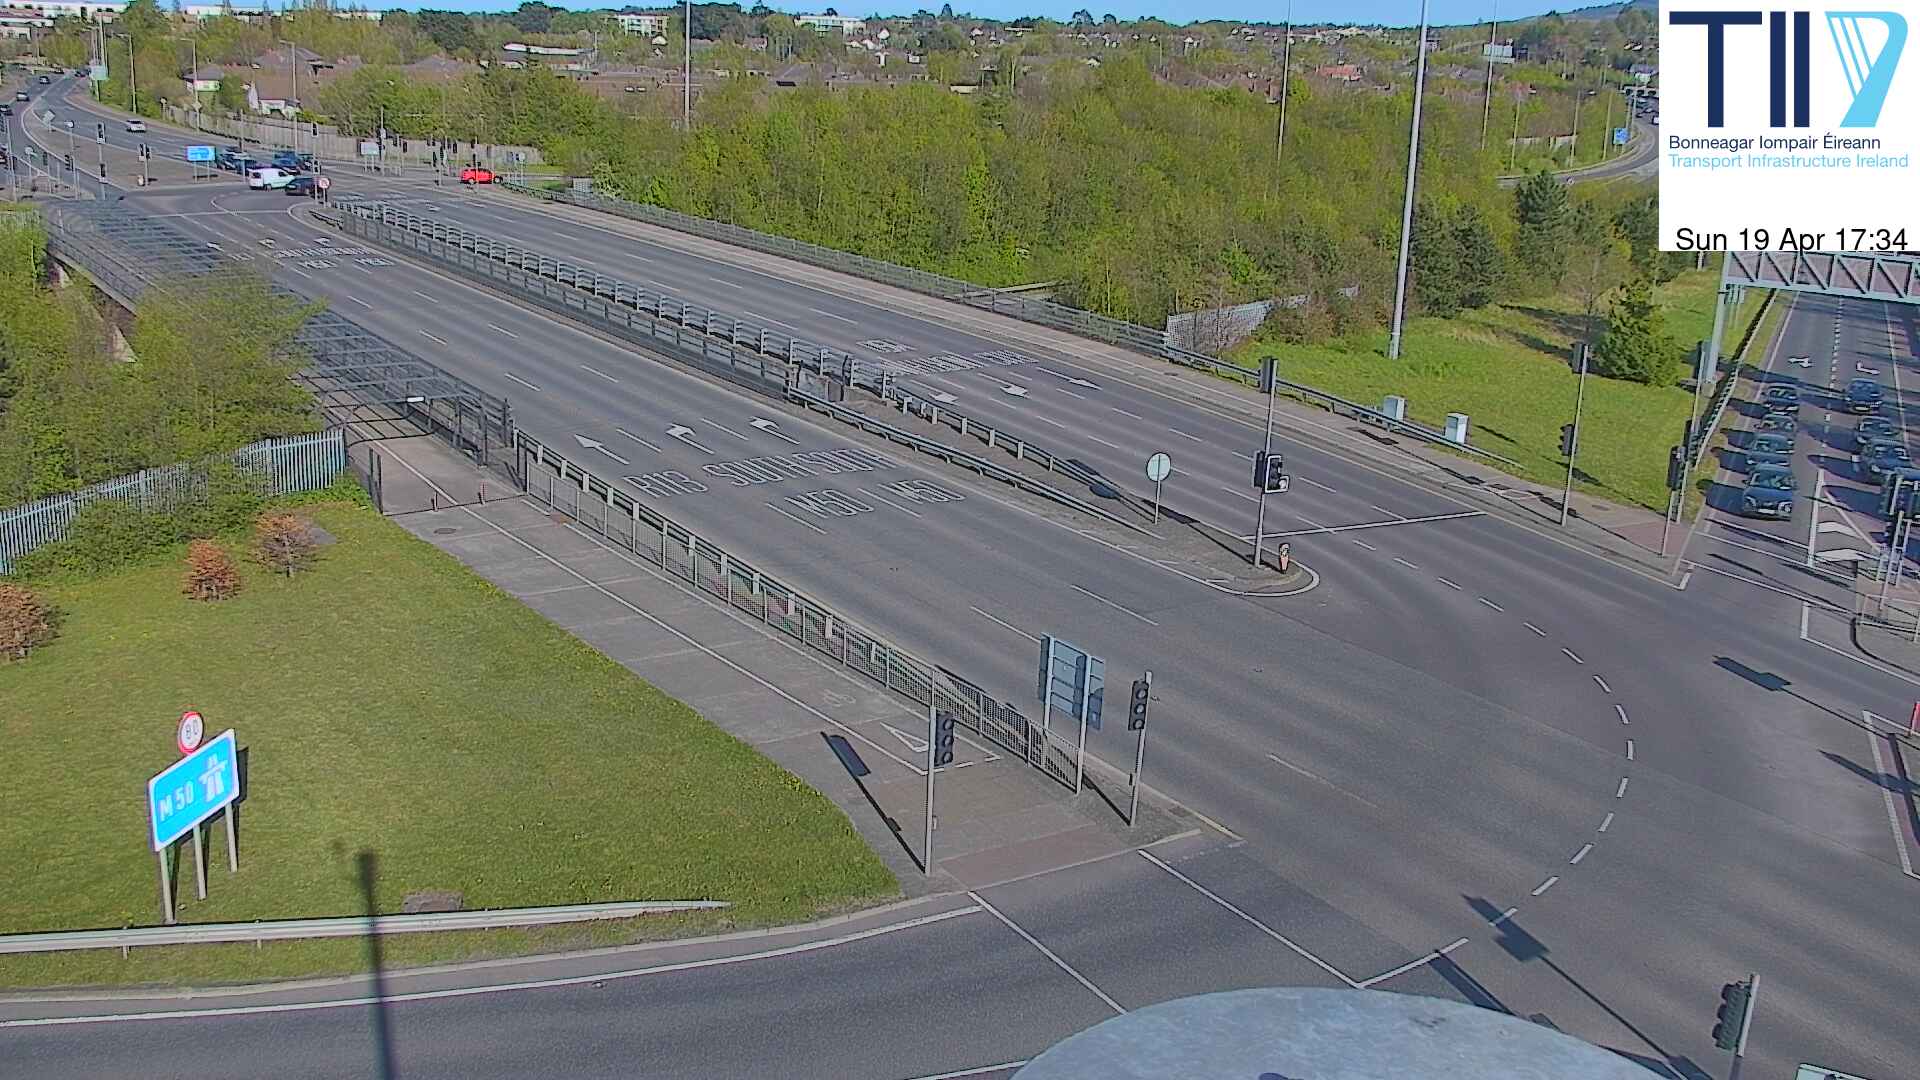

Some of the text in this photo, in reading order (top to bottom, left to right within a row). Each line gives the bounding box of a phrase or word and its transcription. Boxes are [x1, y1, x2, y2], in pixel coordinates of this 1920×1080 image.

[703, 455, 819, 486] SOUTH
[784, 479, 966, 518] M50 M50
